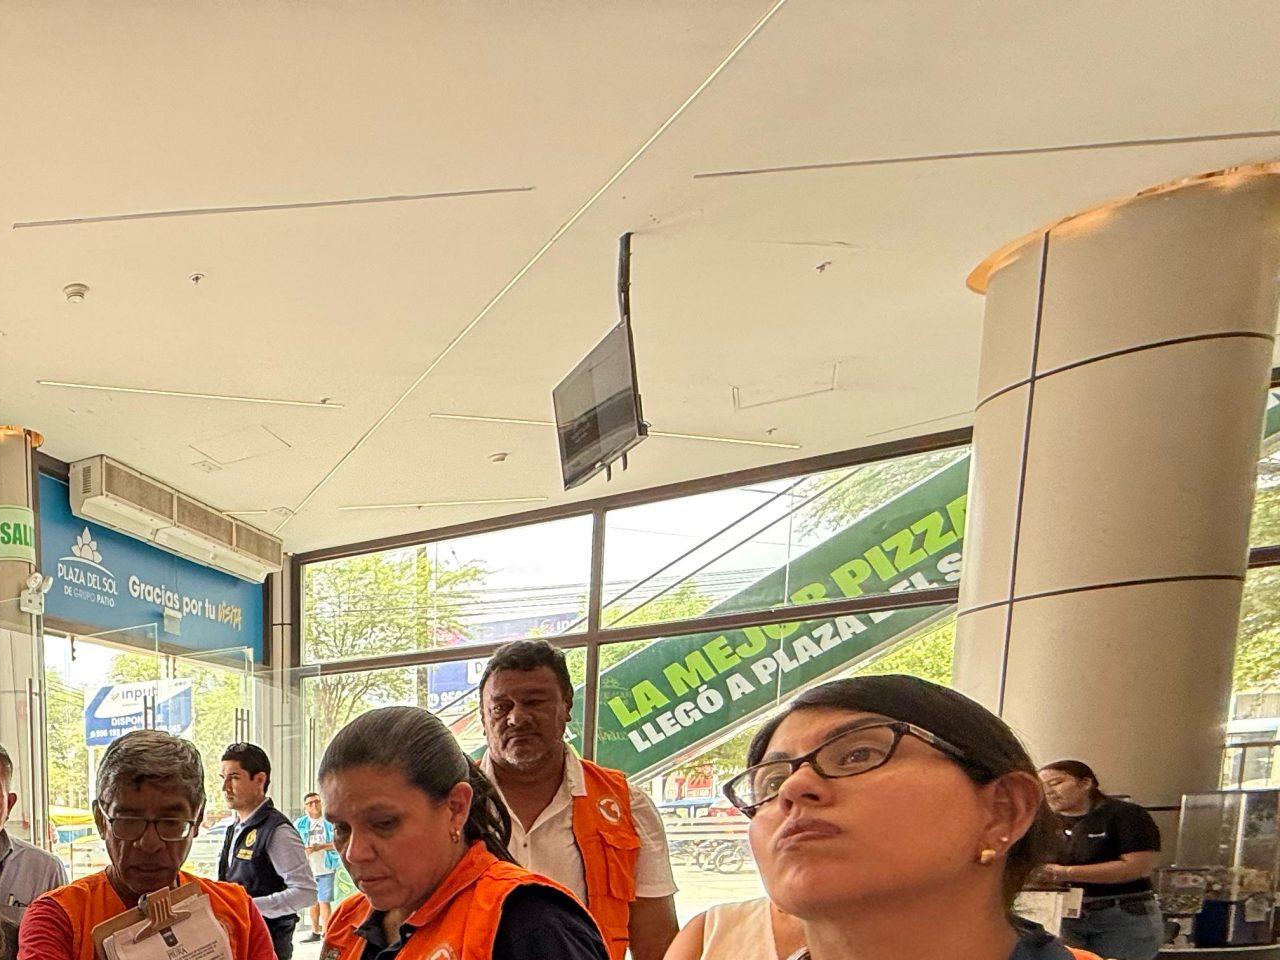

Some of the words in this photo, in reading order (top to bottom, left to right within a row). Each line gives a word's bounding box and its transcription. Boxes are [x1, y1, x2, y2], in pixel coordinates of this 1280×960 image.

[57, 563, 85, 586] PLAZA
[86, 572, 102, 591] DEL
[102, 578, 118, 595] SOL
[64, 585, 73, 597] DE
[73, 588, 96, 603] GRUPO
[96, 596, 115, 608] PATIO
[128, 575, 180, 611] Gracias
[182, 596, 202, 617] por
[204, 598, 216, 620] tu
[607, 679, 671, 728] LA
[627, 685, 724, 753] LLEGÓ
[725, 672, 756, 702] A
[751, 614, 868, 686] PLAZA
